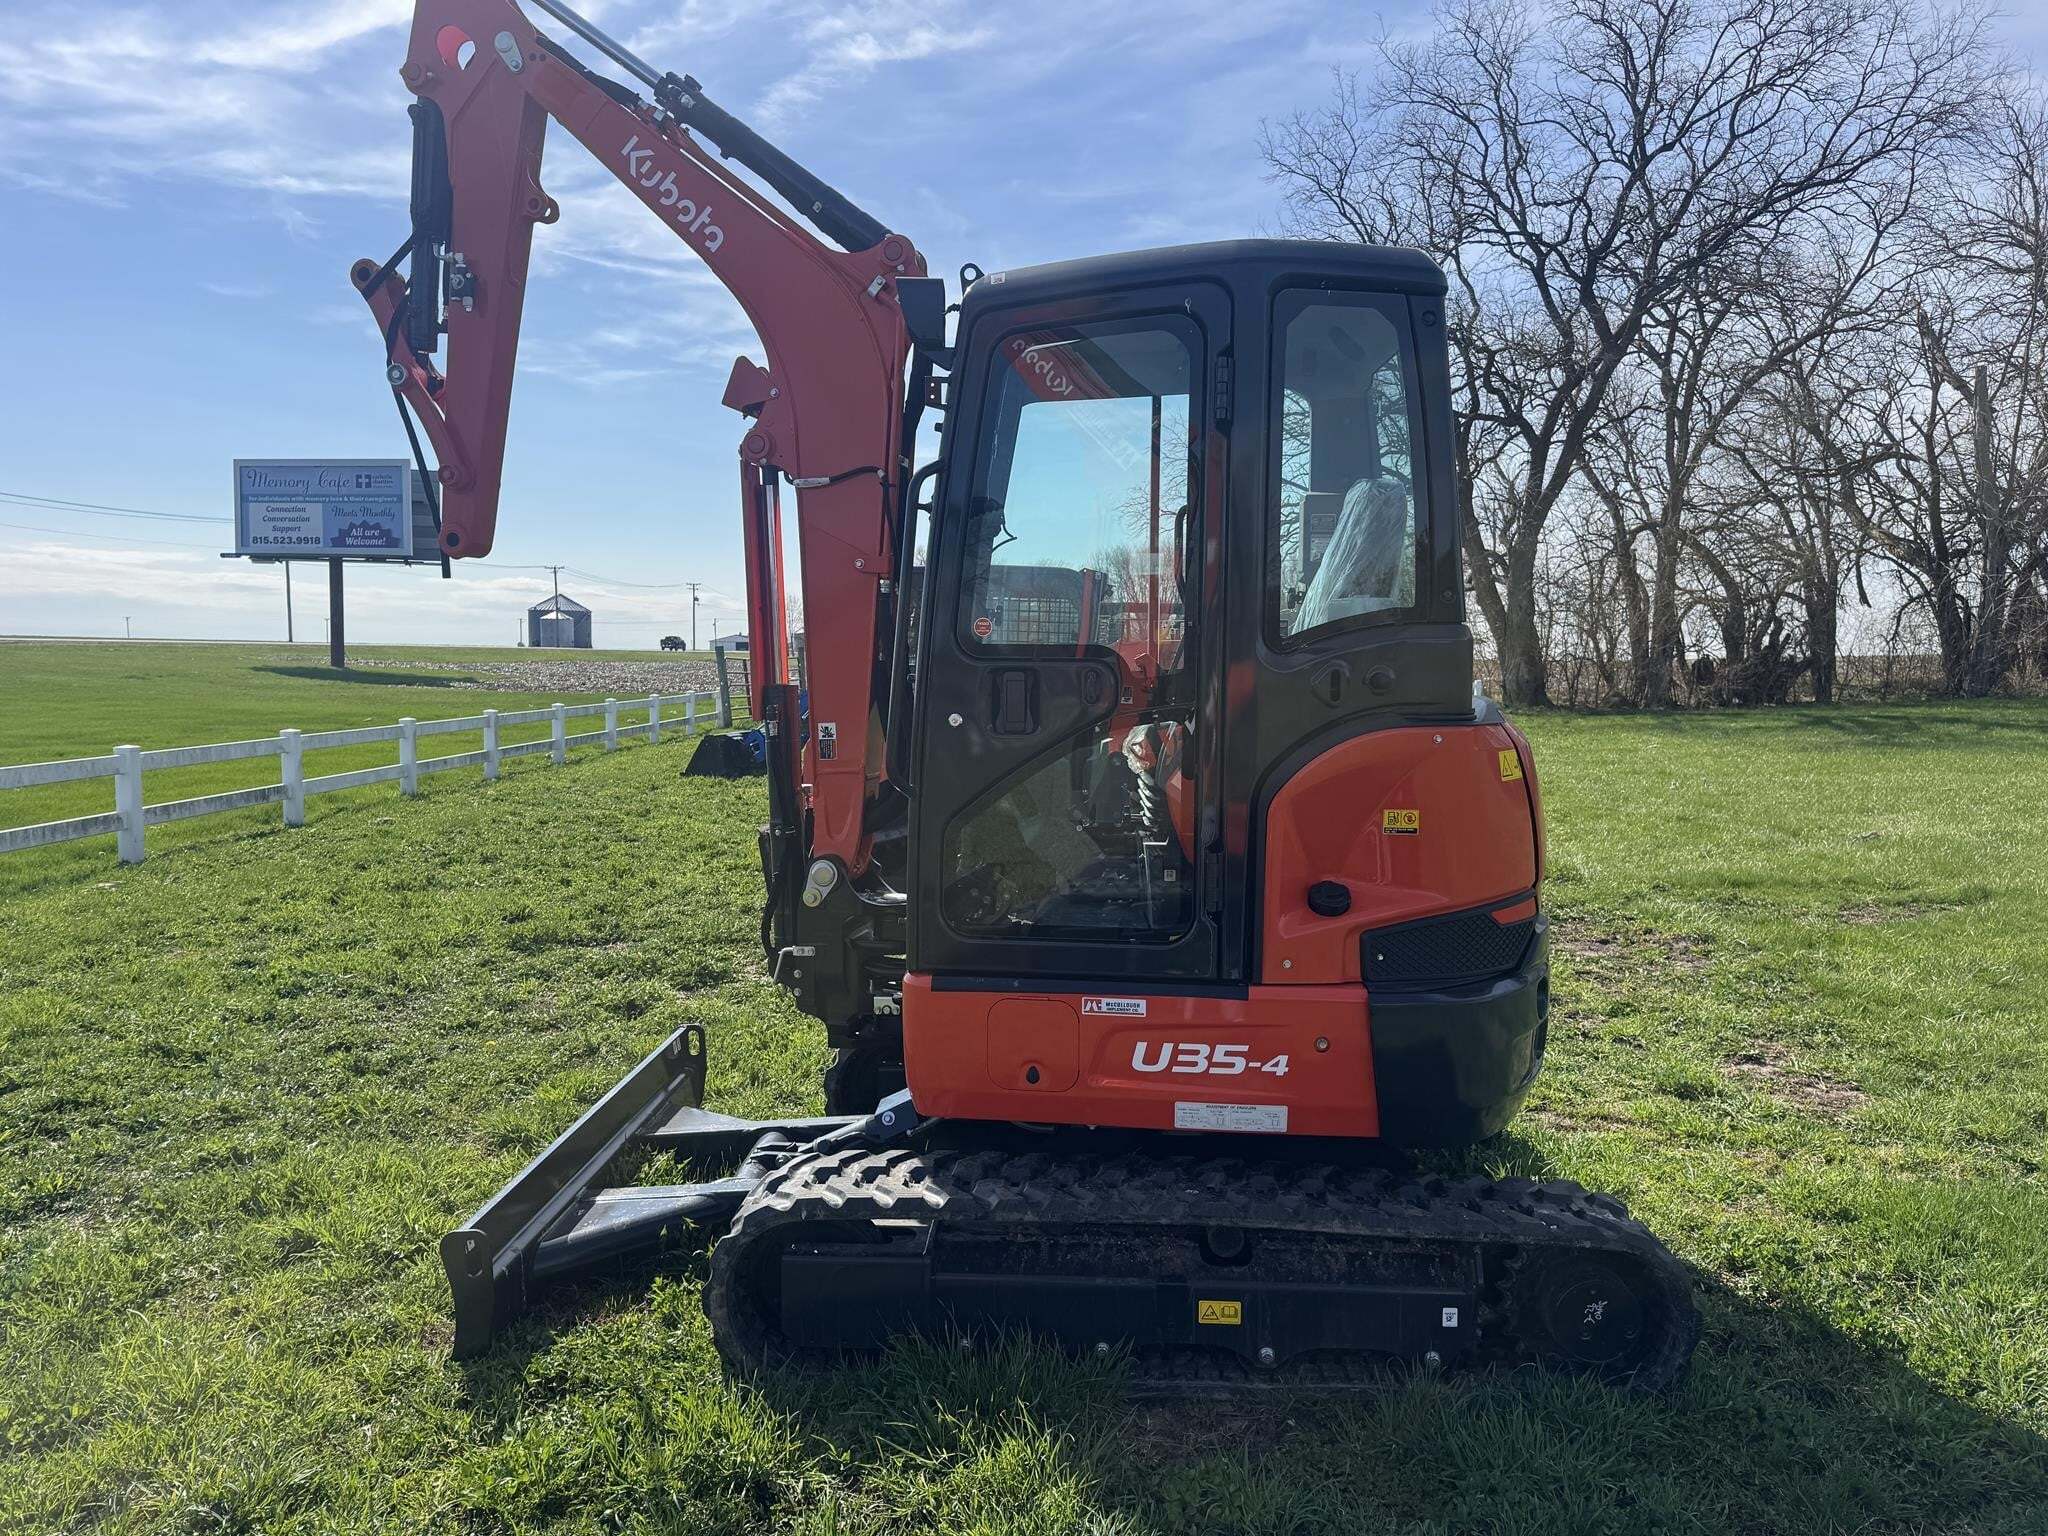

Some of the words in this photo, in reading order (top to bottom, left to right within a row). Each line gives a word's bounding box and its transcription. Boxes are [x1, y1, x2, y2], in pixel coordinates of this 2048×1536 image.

[620, 135, 724, 253] Kubota
[247, 469, 310, 495] Memory
[318, 467, 351, 495] Cafe
[265, 504, 306, 513] Connection
[331, 505, 358, 518] Meets
[359, 505, 396, 520] Monthly
[262, 514, 311, 522] Conversation
[271, 525, 301, 534] Support
[350, 527, 363, 536] All
[252, 536, 321, 545] 815.523.9918
[345, 537, 386, 546] Welcome!
[1132, 1041, 1289, 1076] U35-4
